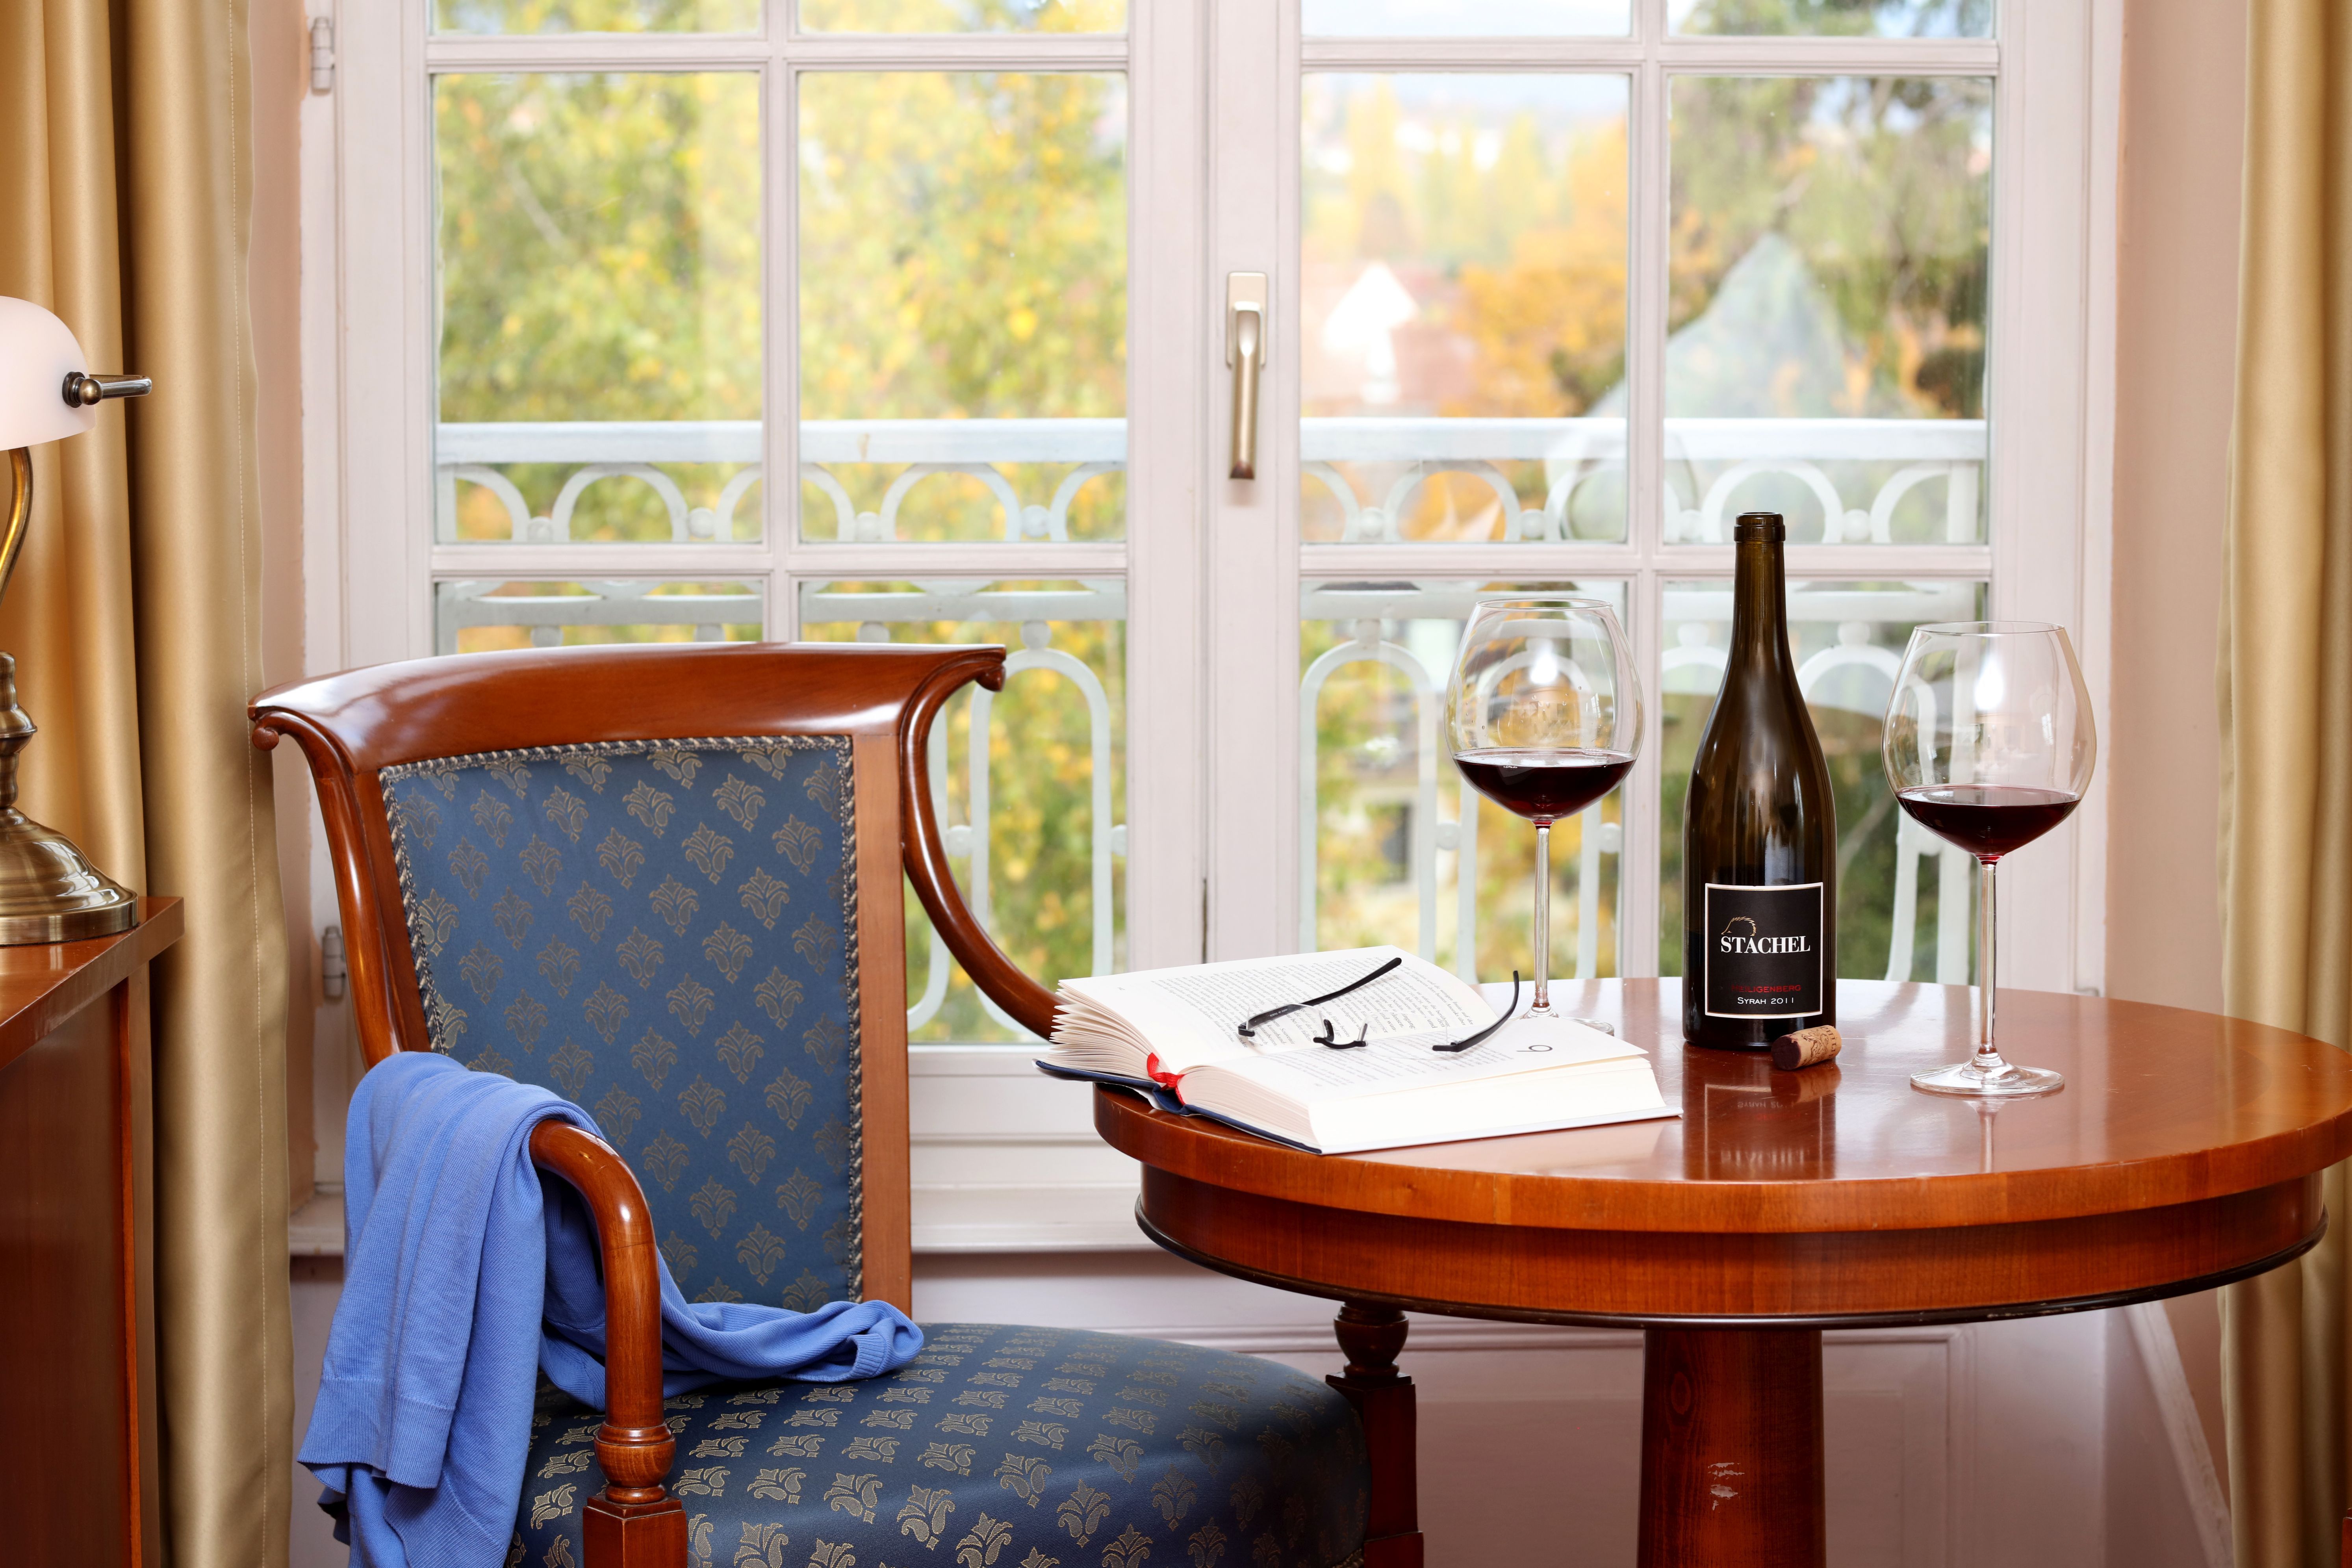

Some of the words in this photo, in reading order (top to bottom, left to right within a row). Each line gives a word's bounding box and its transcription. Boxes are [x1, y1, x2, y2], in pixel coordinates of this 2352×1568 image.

[1721, 935, 1810, 954] STACHEL
[1731, 984, 1802, 993] HEILIGENBERG
[1421, 996, 1432, 1004] sofort
[1435, 993, 1447, 1003] bunten
[1446, 1003, 1459, 1017] Anoraks
[1440, 990, 1453, 1001] wenigen
[1452, 1002, 1462, 1011] Inuits
[1224, 1023, 1236, 1031] Hotel
[1233, 1032, 1250, 1048] entdeckte
[1267, 1025, 1287, 1045] kunsthand-
[1280, 1028, 1295, 1044] Souvenir
[1301, 1030, 1316, 1043] fallen-
[1339, 1026, 1350, 1037] bereits
